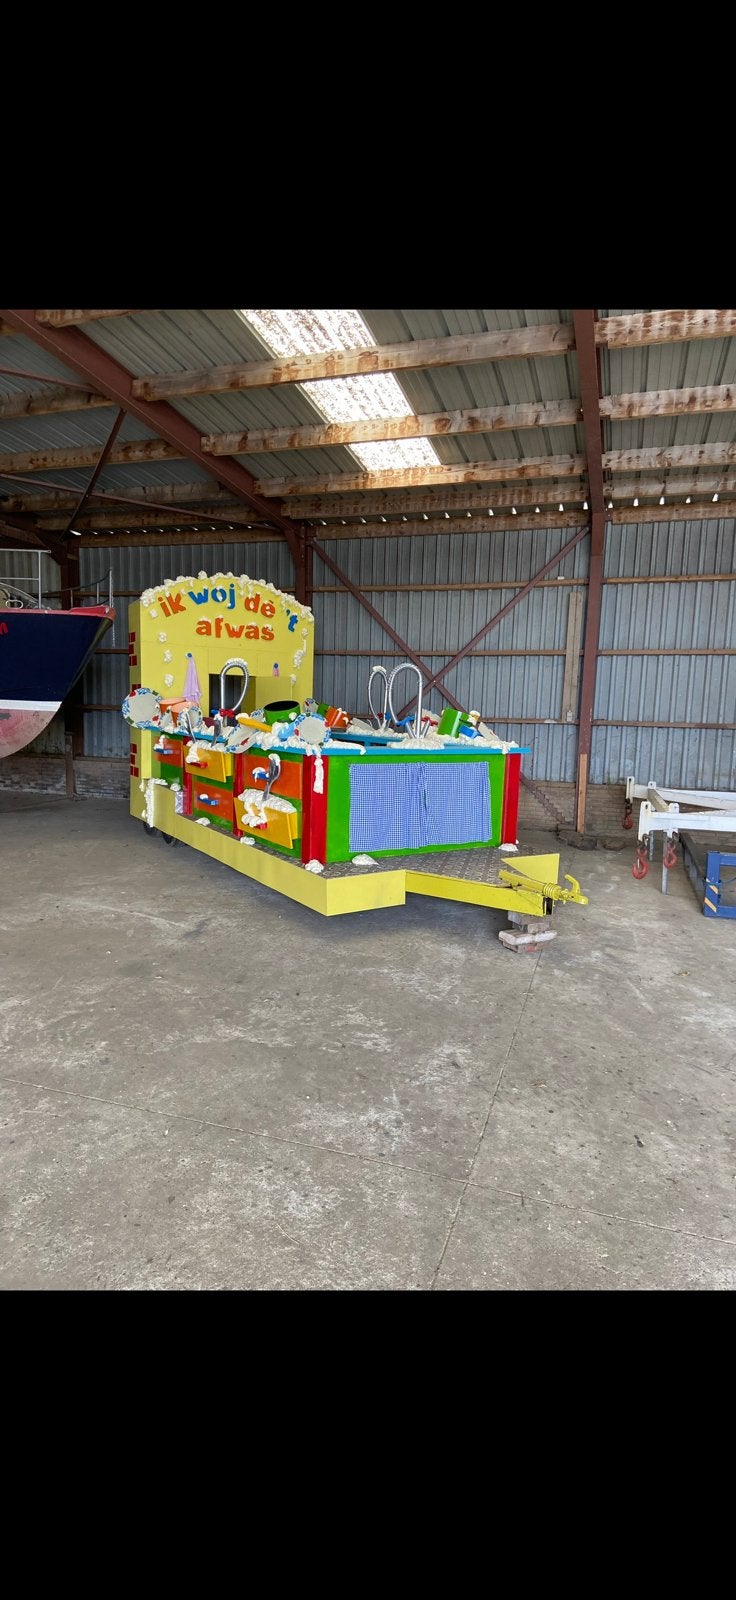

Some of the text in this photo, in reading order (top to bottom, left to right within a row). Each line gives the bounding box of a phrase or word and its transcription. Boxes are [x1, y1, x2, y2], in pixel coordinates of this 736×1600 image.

[157, 592, 187, 618] ik
[187, 582, 236, 610] woj
[195, 616, 275, 641] afwas
